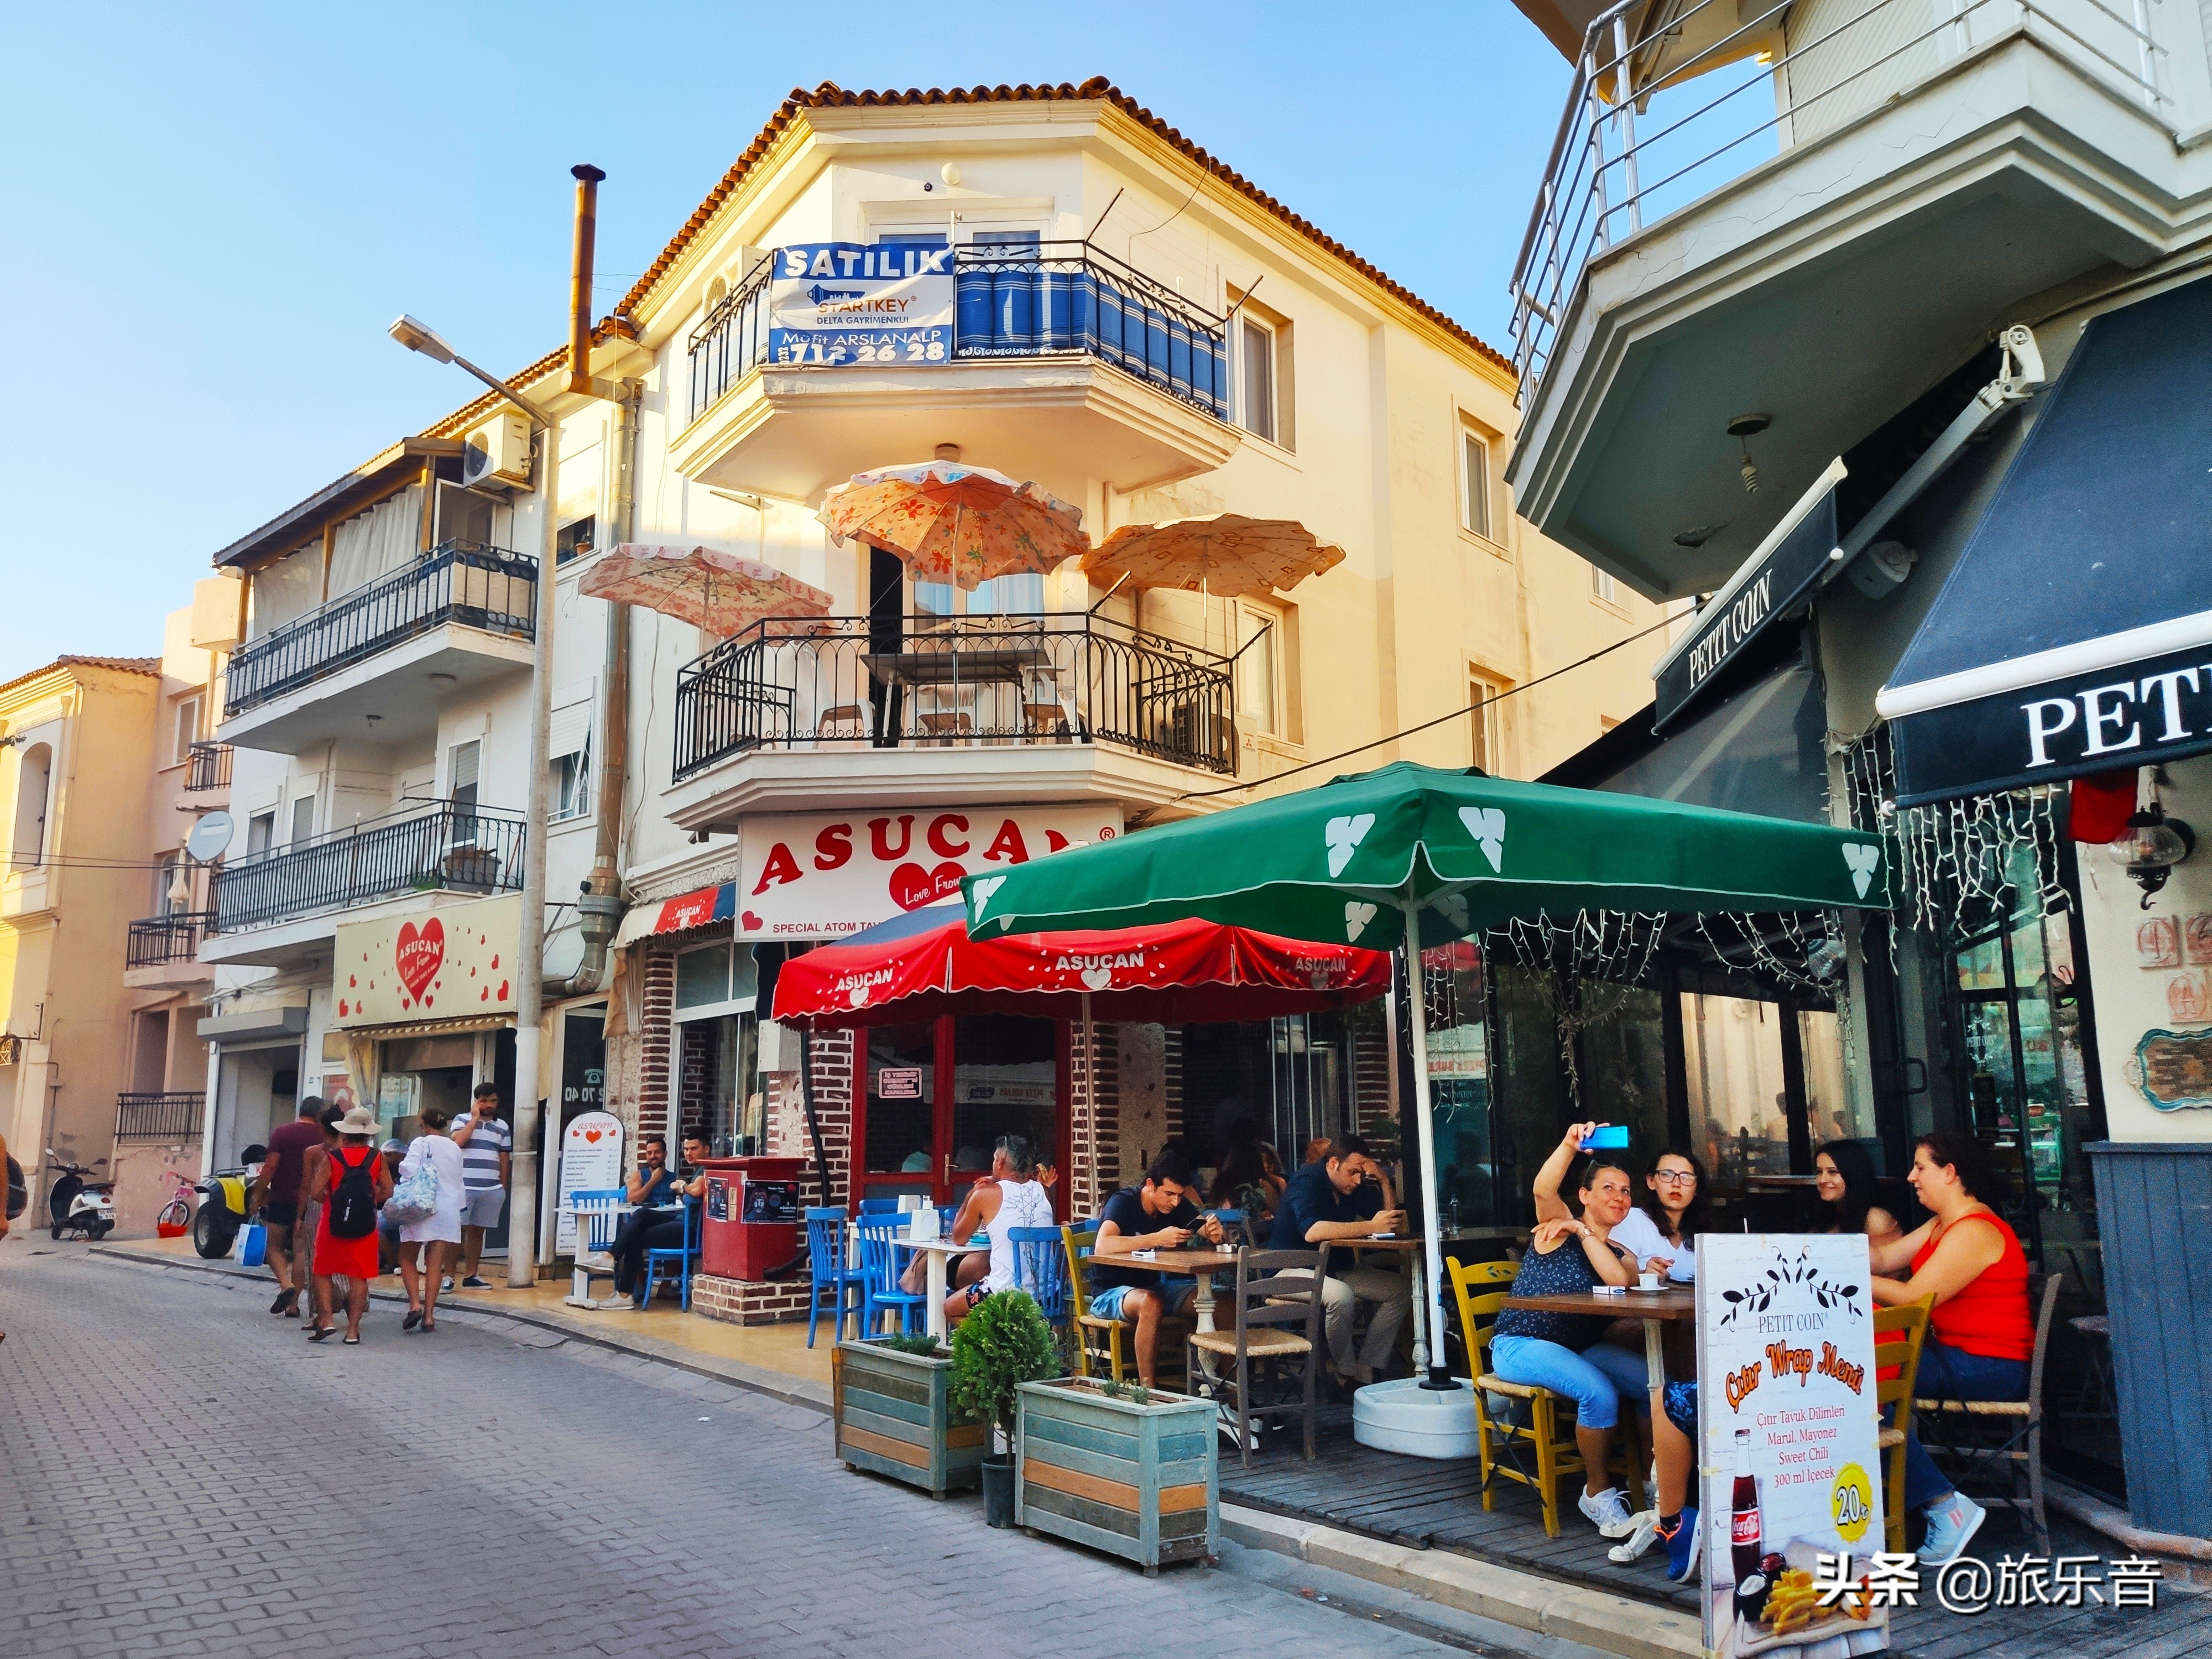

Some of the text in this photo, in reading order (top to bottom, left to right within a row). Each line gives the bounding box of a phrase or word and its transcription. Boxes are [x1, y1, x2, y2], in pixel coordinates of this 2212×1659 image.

[784, 249, 945, 278] SATILIK
[818, 299, 909, 312] STARTKEY
[817, 314, 911, 325] DELTA GAYRİMENKUL
[833, 330, 942, 346] ARSLANALP
[857, 345, 896, 362] 26
[906, 342, 945, 361] 28
[1688, 568, 1773, 690] PETIT COIN
[905, 887, 931, 905] Love
[675, 904, 701, 919] ASUCAN
[773, 924, 821, 933] SPECIAL
[824, 922, 857, 932] ATOM
[398, 939, 440, 963] ASUCAN
[1055, 952, 1144, 971] ASUCAN
[1295, 957, 1346, 972] ASUCAN
[834, 968, 893, 992] ASUCAN
[1757, 1312, 1825, 1333] PETIT COIN
[1725, 1339, 1865, 1414] Çıtır Wrap Menü
[1757, 1404, 1845, 1430] Çıtır Tavuk Dilimleri
[1799, 1428, 1838, 1443] Mayonez
[1778, 1446, 1829, 1465] Sweet Chili
[1774, 1465, 1835, 1488] 300 ml İçecek
